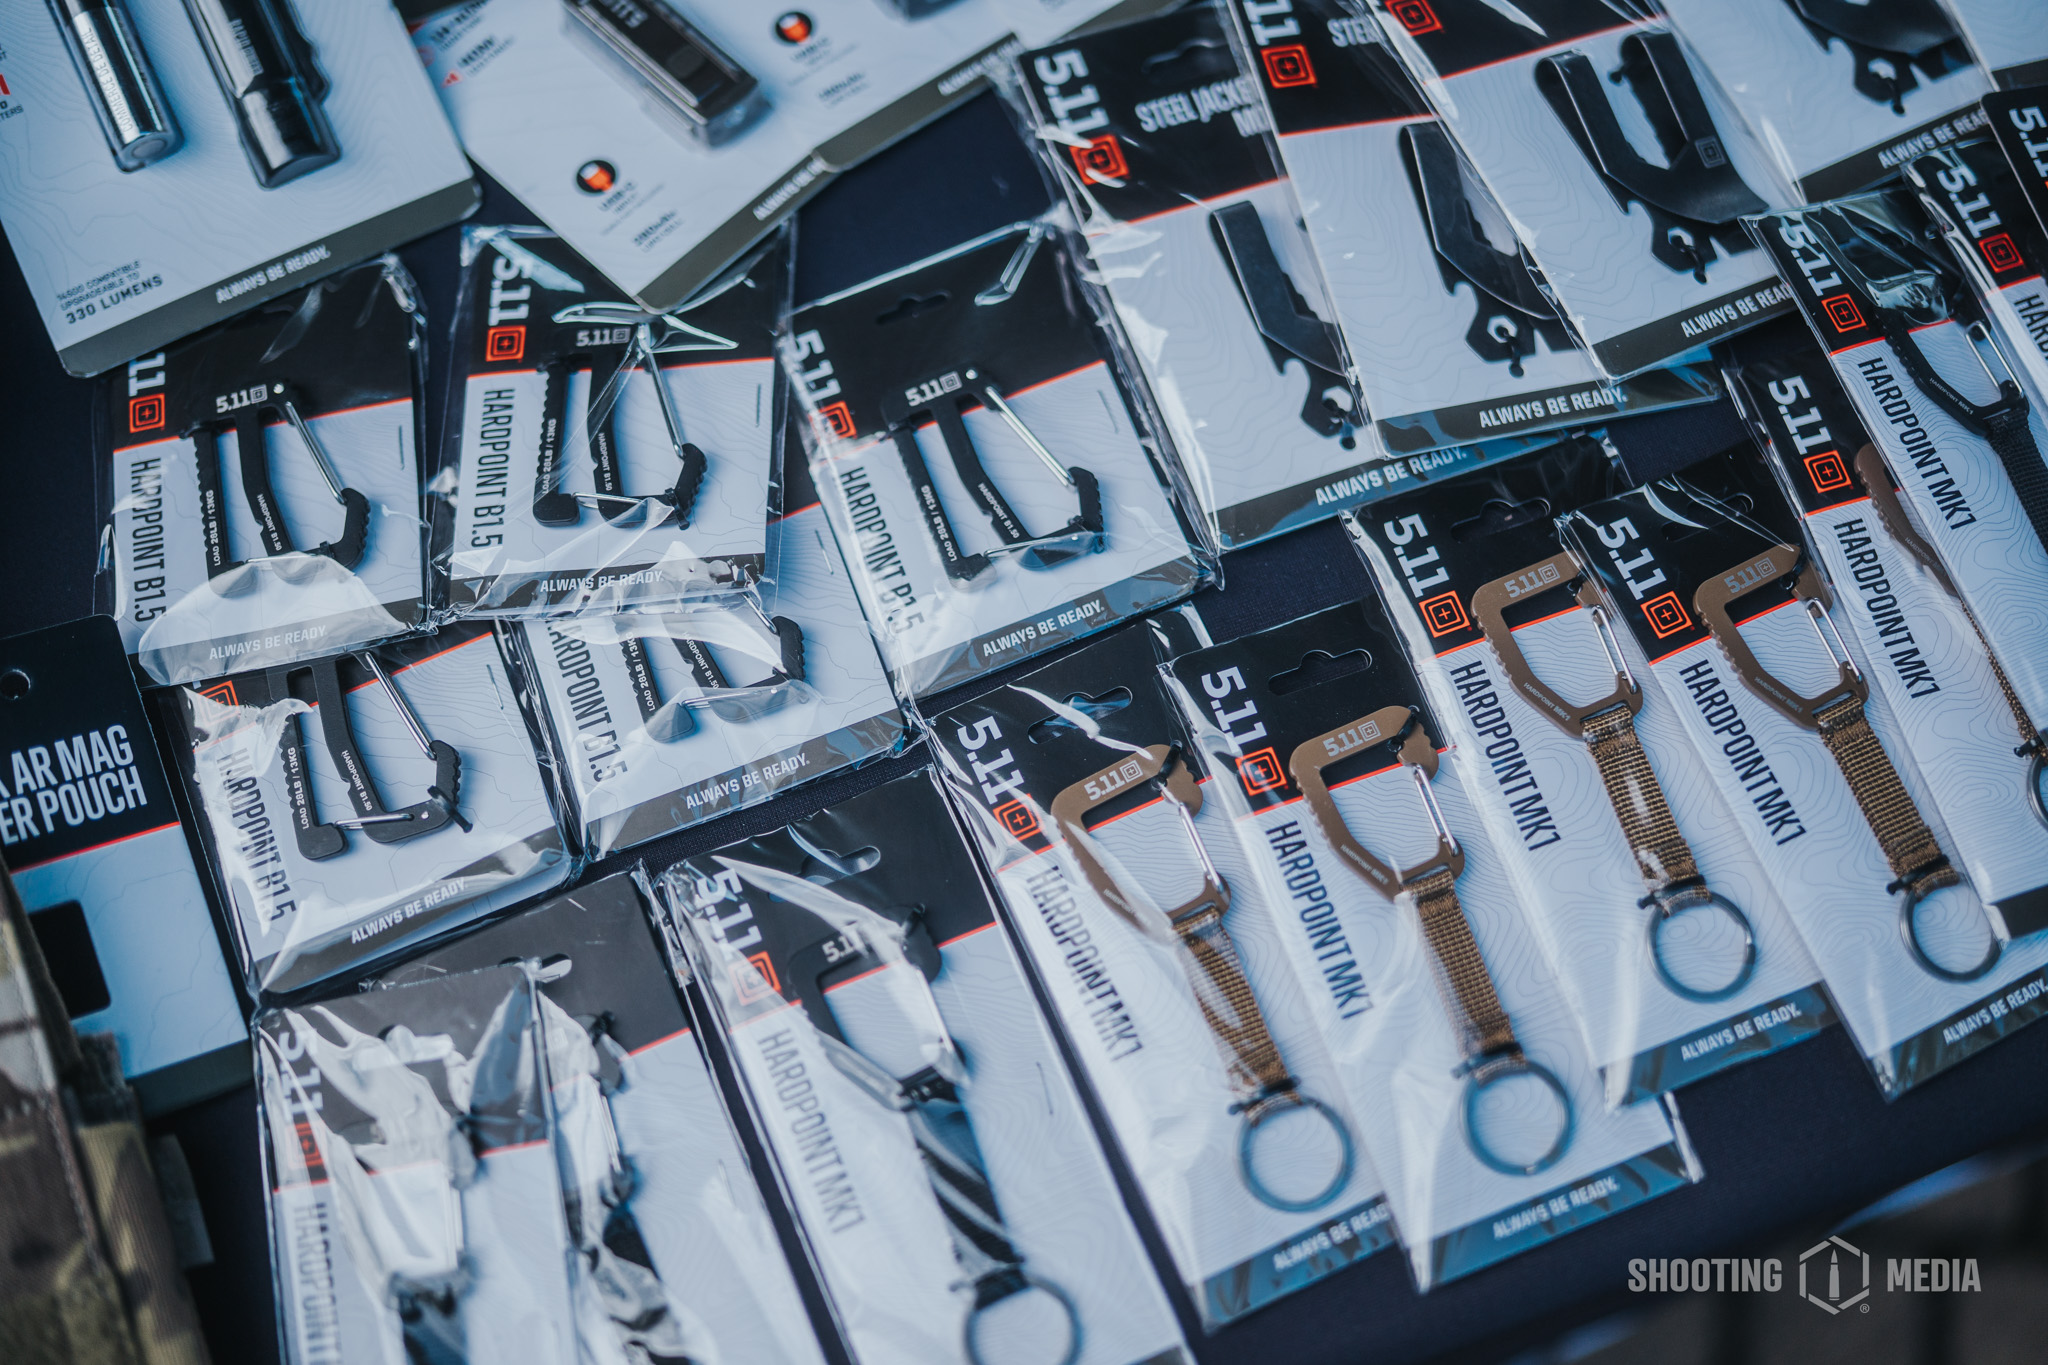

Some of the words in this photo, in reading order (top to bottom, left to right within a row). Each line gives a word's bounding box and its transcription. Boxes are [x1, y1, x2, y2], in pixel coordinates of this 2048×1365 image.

[1243, 0, 1301, 46] 11
[1034, 48, 1110, 135] 5.11
[1135, 92, 1199, 133] STEEL
[1878, 131, 1936, 169] ALWAYS
[1932, 124, 1957, 144] BE
[1953, 110, 1989, 136] READ
[1936, 166, 2001, 239] 5.11
[1778, 222, 1843, 297] 5.11
[66, 304, 96, 325] 330
[100, 274, 163, 310] LUMENS
[215, 272, 266, 304] ALWAYS
[266, 263, 287, 282] BE
[488, 255, 531, 325] 5.11
[1680, 303, 1738, 338] ALWAYS
[1734, 296, 1759, 316] BE
[1755, 283, 1793, 309] READ
[576, 329, 612, 348] 5.11
[128, 352, 165, 397] 11
[905, 378, 944, 407] 5.11
[216, 391, 251, 413] 5.11
[1479, 401, 1546, 428] ALWAYS
[1545, 395, 1571, 416] BE
[1768, 376, 1834, 455] 5.11
[476, 388, 515, 497] HARDPOINT
[598, 432, 610, 471] HARDPOINT
[1857, 357, 1940, 488] HARDPOINT
[1928, 477, 1978, 531] MK1
[978, 482, 1008, 520] HARDPOINT
[1315, 469, 1383, 506] ALWAYS
[1383, 461, 1409, 483] BE
[131, 457, 164, 572] HARDPOINT
[257, 493, 276, 532] HARDPOINT
[471, 504, 505, 548] B1.5
[840, 466, 906, 583] HARDPOINT
[212, 546, 221, 566] LOAD
[944, 541, 957, 562] LOAD
[1384, 514, 1450, 598] 5.11
[1598, 516, 1667, 601] 5.11
[134, 573, 167, 623] B1.5
[540, 577, 594, 592] ALWAYS
[598, 576, 615, 588] BE
[1505, 569, 1542, 598] 5.11
[1723, 564, 1761, 593] 5.11
[1833, 518, 1915, 648] HARDPOINT
[1889, 647, 1941, 699] MK1
[209, 639, 261, 660] ALWAYS
[264, 634, 281, 649] BE
[983, 626, 1036, 656] ALWAYS
[1037, 618, 1057, 635] BE
[644, 690, 656, 711] LOAD
[1201, 666, 1268, 751] 5.11
[1524, 682, 1555, 708] HARDPOINT
[11, 750, 58, 795] AR
[54, 725, 134, 782] MAG
[288, 747, 298, 773] 13KG
[583, 729, 628, 782] B1.5
[957, 716, 1025, 804] 5.11
[1323, 730, 1363, 758] 5.11
[1450, 660, 1538, 794] HARDPOINT
[1508, 791, 1561, 852] MK1
[1678, 658, 1777, 797] HARDPOINT
[1756, 790, 1806, 846] MK1
[36, 765, 148, 834] POUCH
[294, 781, 305, 806] 28LB
[342, 750, 364, 790] HARDPOINT
[360, 791, 373, 811] B1.50
[686, 779, 740, 809] ALWAYS
[742, 771, 761, 788] BE
[1084, 769, 1123, 801] 5.11
[216, 747, 283, 877] HARDPOINT
[300, 808, 309, 829] LOAD
[351, 910, 403, 944] ALWAYS
[404, 900, 423, 918] BE
[696, 868, 762, 960] 5.11
[1265, 820, 1352, 962] HARDPOINT
[1323, 958, 1374, 1020] MK1
[1026, 864, 1114, 1010] HARDPOINT
[1093, 1002, 1144, 1062] MK1
[1681, 1027, 1736, 1062] ALWAYS
[1734, 1020, 1754, 1040] BE
[1943, 1007, 1992, 1046] ALWAYS
[1989, 998, 2009, 1020] BE
[757, 1029, 845, 1170] HARDPOINT
[811, 1165, 867, 1234] MK1
[1493, 1204, 1550, 1240] ALWAYS
[1548, 1194, 1570, 1216] BE
[1273, 1231, 1332, 1272] ALWAYS
[1329, 1221, 1354, 1244] BE
